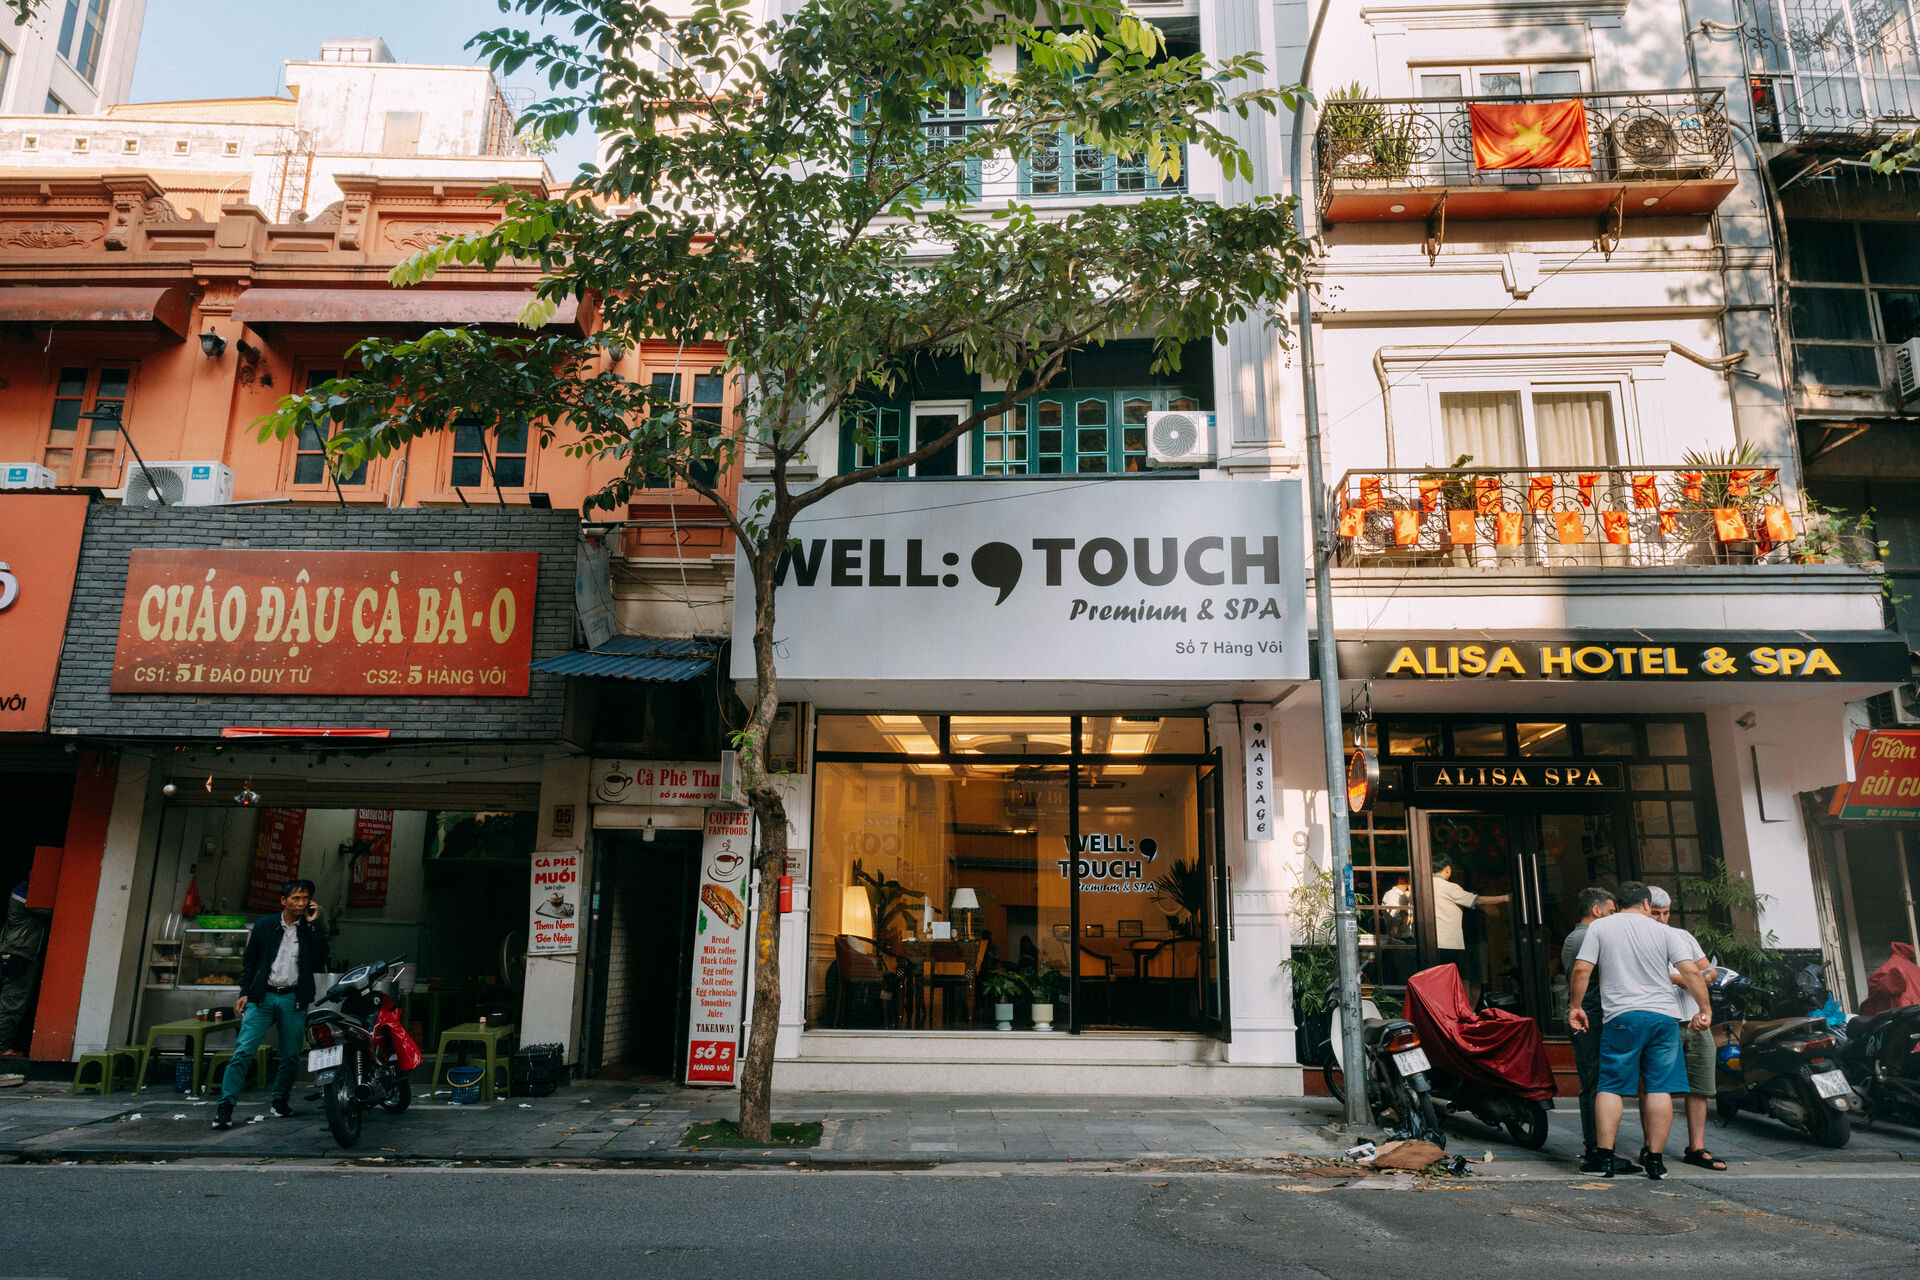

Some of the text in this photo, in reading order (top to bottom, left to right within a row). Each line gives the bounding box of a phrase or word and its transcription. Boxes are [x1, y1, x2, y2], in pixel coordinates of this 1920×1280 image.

[1033, 536, 1280, 587] TOUCH
[138, 568, 247, 643] CHÁO
[254, 568, 345, 658] ĐẬU
[352, 570, 404, 644] CÀ
[1069, 597, 1281, 624] Premium & SPA
[1175, 639, 1284, 658] Số 7 Hàng Vôi
[1387, 645, 1843, 678] ALISA HOTEL & SPA
[134, 663, 313, 684] CS1: 51 ĐÀO DUY TỪ
[366, 665, 507, 685] CS2: 5 HÀNG VÔI
[1871, 736, 1918, 763] Tiệm
[636, 768, 654, 786] Cà
[659, 768, 688, 787] Phê
[1434, 767, 1604, 787] ALISA SPA
[1860, 769, 1894, 796] GỎI
[555, 808, 572, 824] 05
[709, 811, 749, 826] COFFEE
[708, 825, 748, 836] FASTFOODS
[1293, 830, 1309, 855] 9
[553, 855, 576, 867] PHÊ
[1057, 859, 1143, 880] TOUCH
[534, 867, 576, 885] MUỐI
[1122, 881, 1130, 892] &
[1133, 881, 1156, 893] SPA
[555, 919, 575, 932] Ngon
[711, 935, 730, 944] Bread
[703, 945, 737, 955] Milk coffee
[700, 956, 717, 965] Black
[703, 967, 734, 976] Egg coffee
[701, 977, 734, 987] Salt coffee
[695, 988, 738, 998] Egg chocolate
[700, 998, 732, 1008] Smoothies
[707, 1009, 724, 1018] Juice
[696, 1023, 736, 1034] TAKEAWAY
[694, 1041, 730, 1060] SỐ 5
